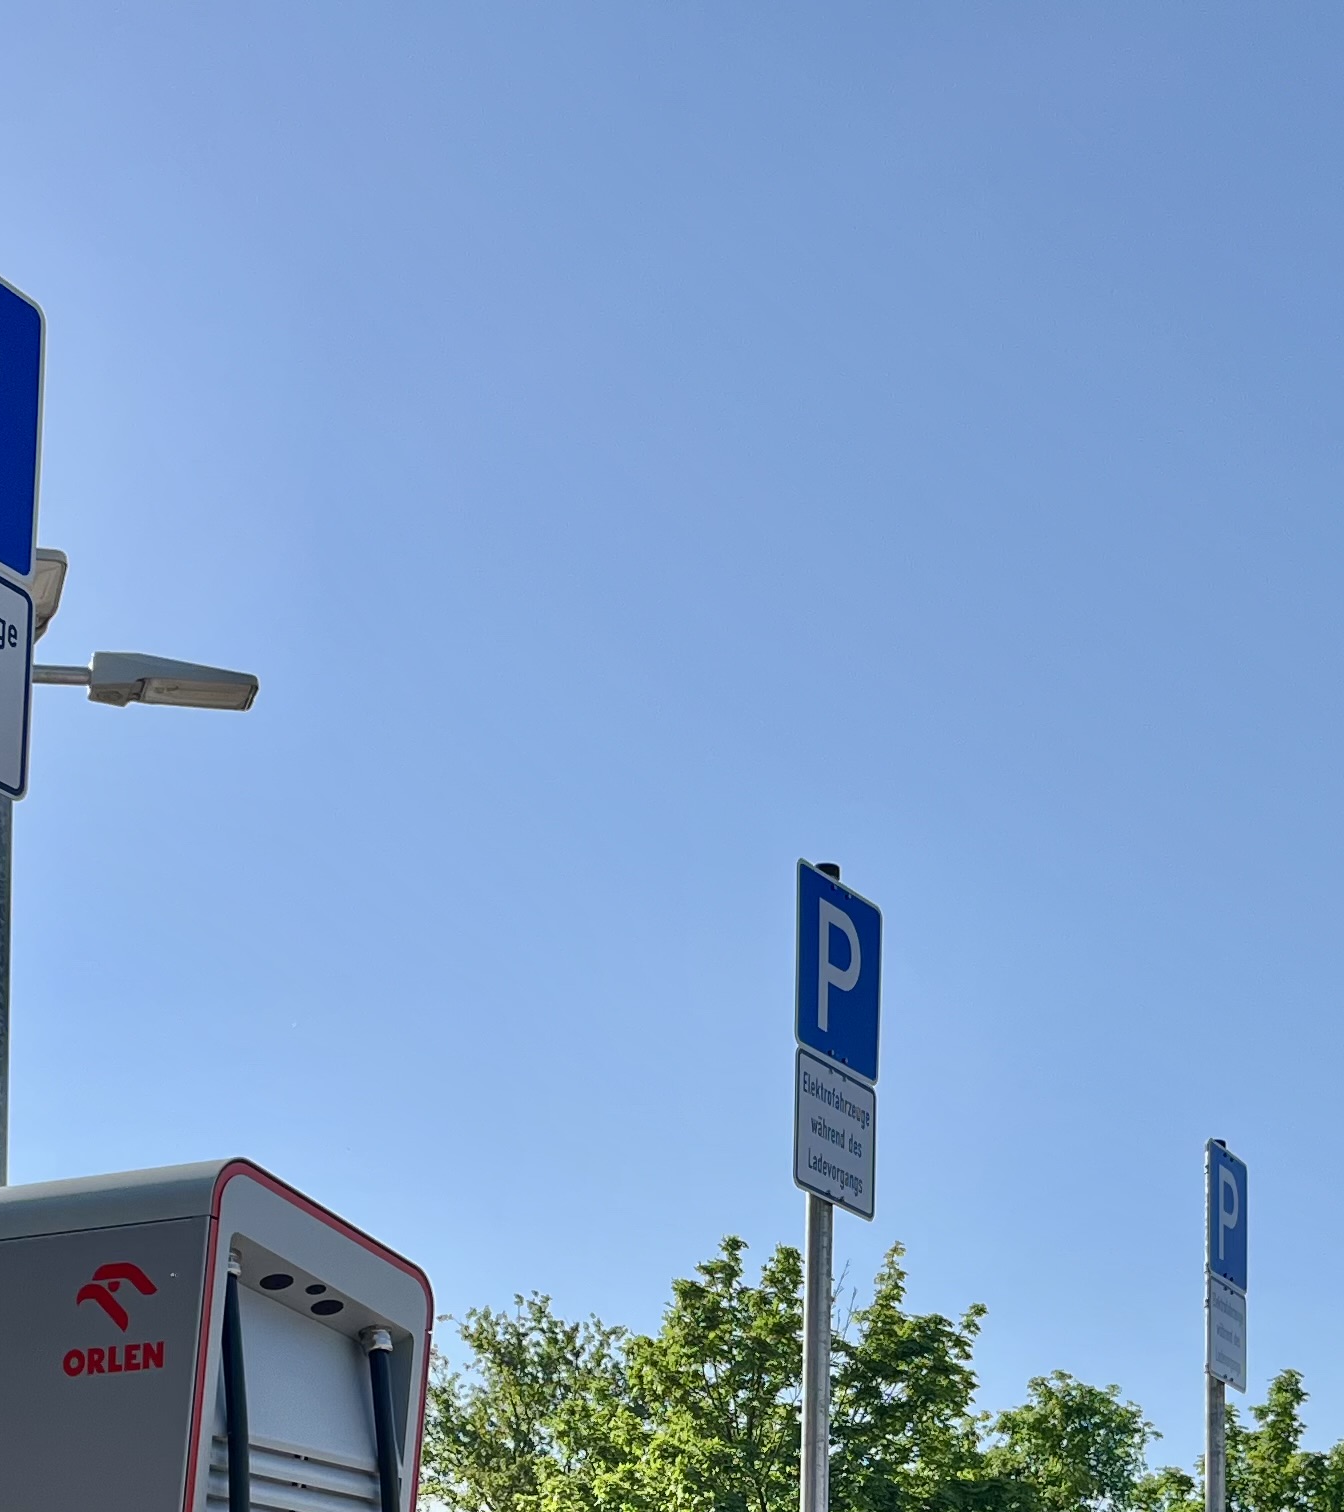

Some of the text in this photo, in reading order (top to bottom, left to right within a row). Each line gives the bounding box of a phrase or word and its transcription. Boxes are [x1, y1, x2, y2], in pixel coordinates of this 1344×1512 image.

[817, 896, 862, 1033] P
[802, 1071, 870, 1130] Elektrofahrzeuge
[810, 1115, 863, 1159] während des
[807, 1147, 863, 1197] Ladevorgangs
[1218, 1163, 1240, 1261] P
[62, 1340, 165, 1378] ORLEN
